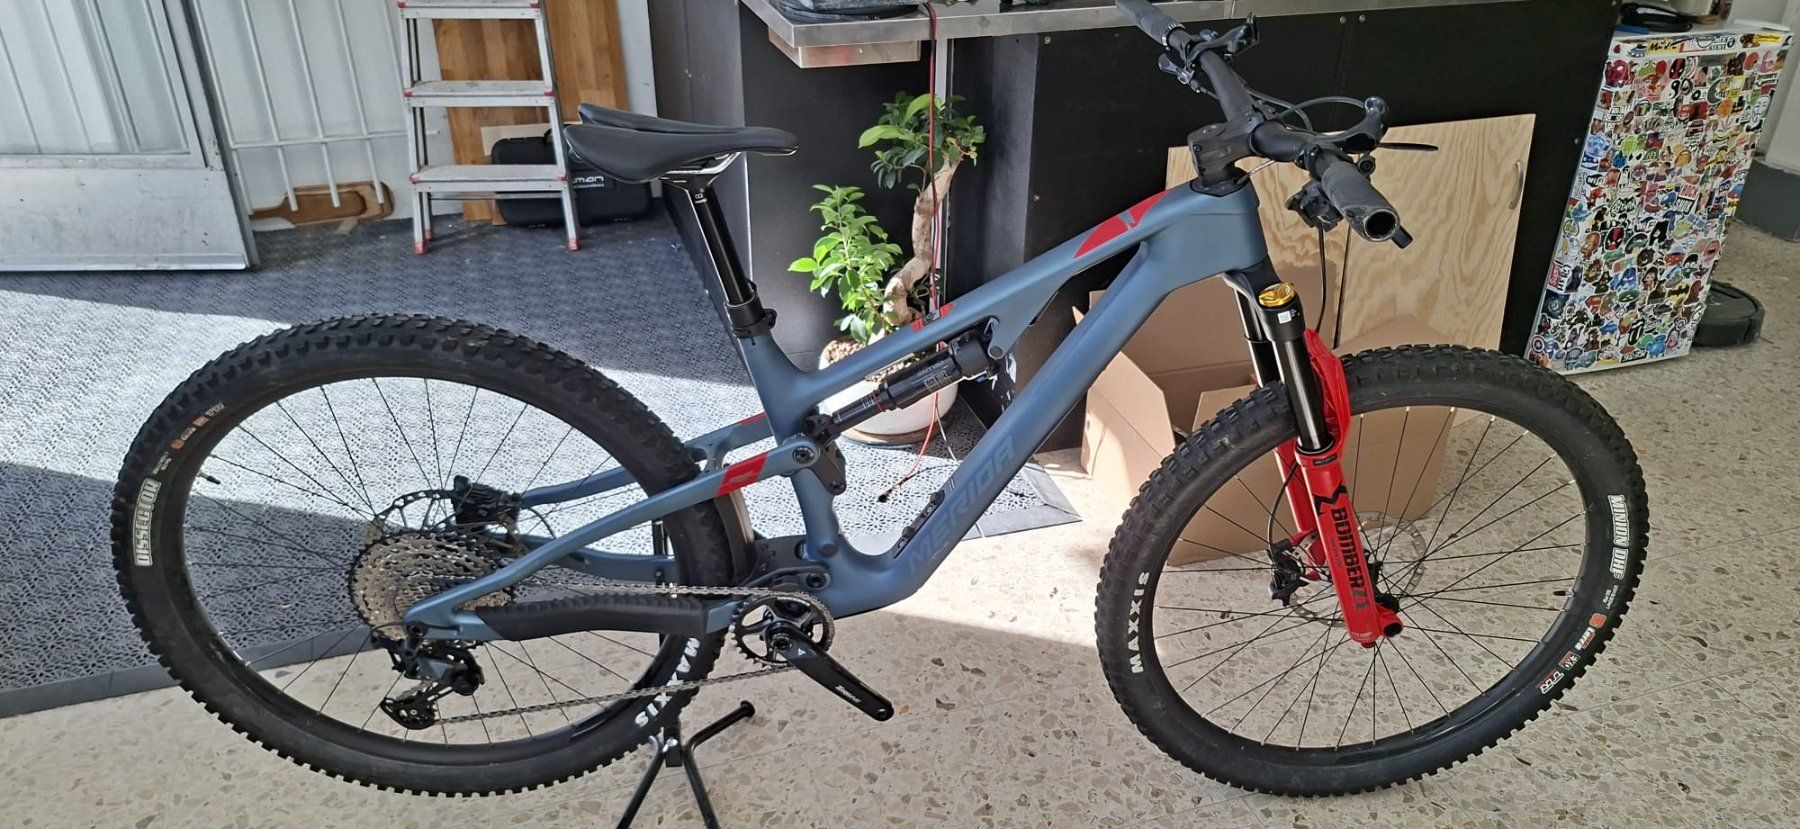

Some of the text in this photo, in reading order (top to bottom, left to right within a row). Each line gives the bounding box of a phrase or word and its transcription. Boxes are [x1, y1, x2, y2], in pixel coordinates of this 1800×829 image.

[133, 477, 162, 567] DISSECTOR
[1331, 506, 1366, 588] BOMBER
[1608, 494, 1629, 546] MINION
[1609, 546, 1629, 579] DHF
[1127, 572, 1150, 674] MAXXIS
[635, 638, 701, 727] MAXXIS
